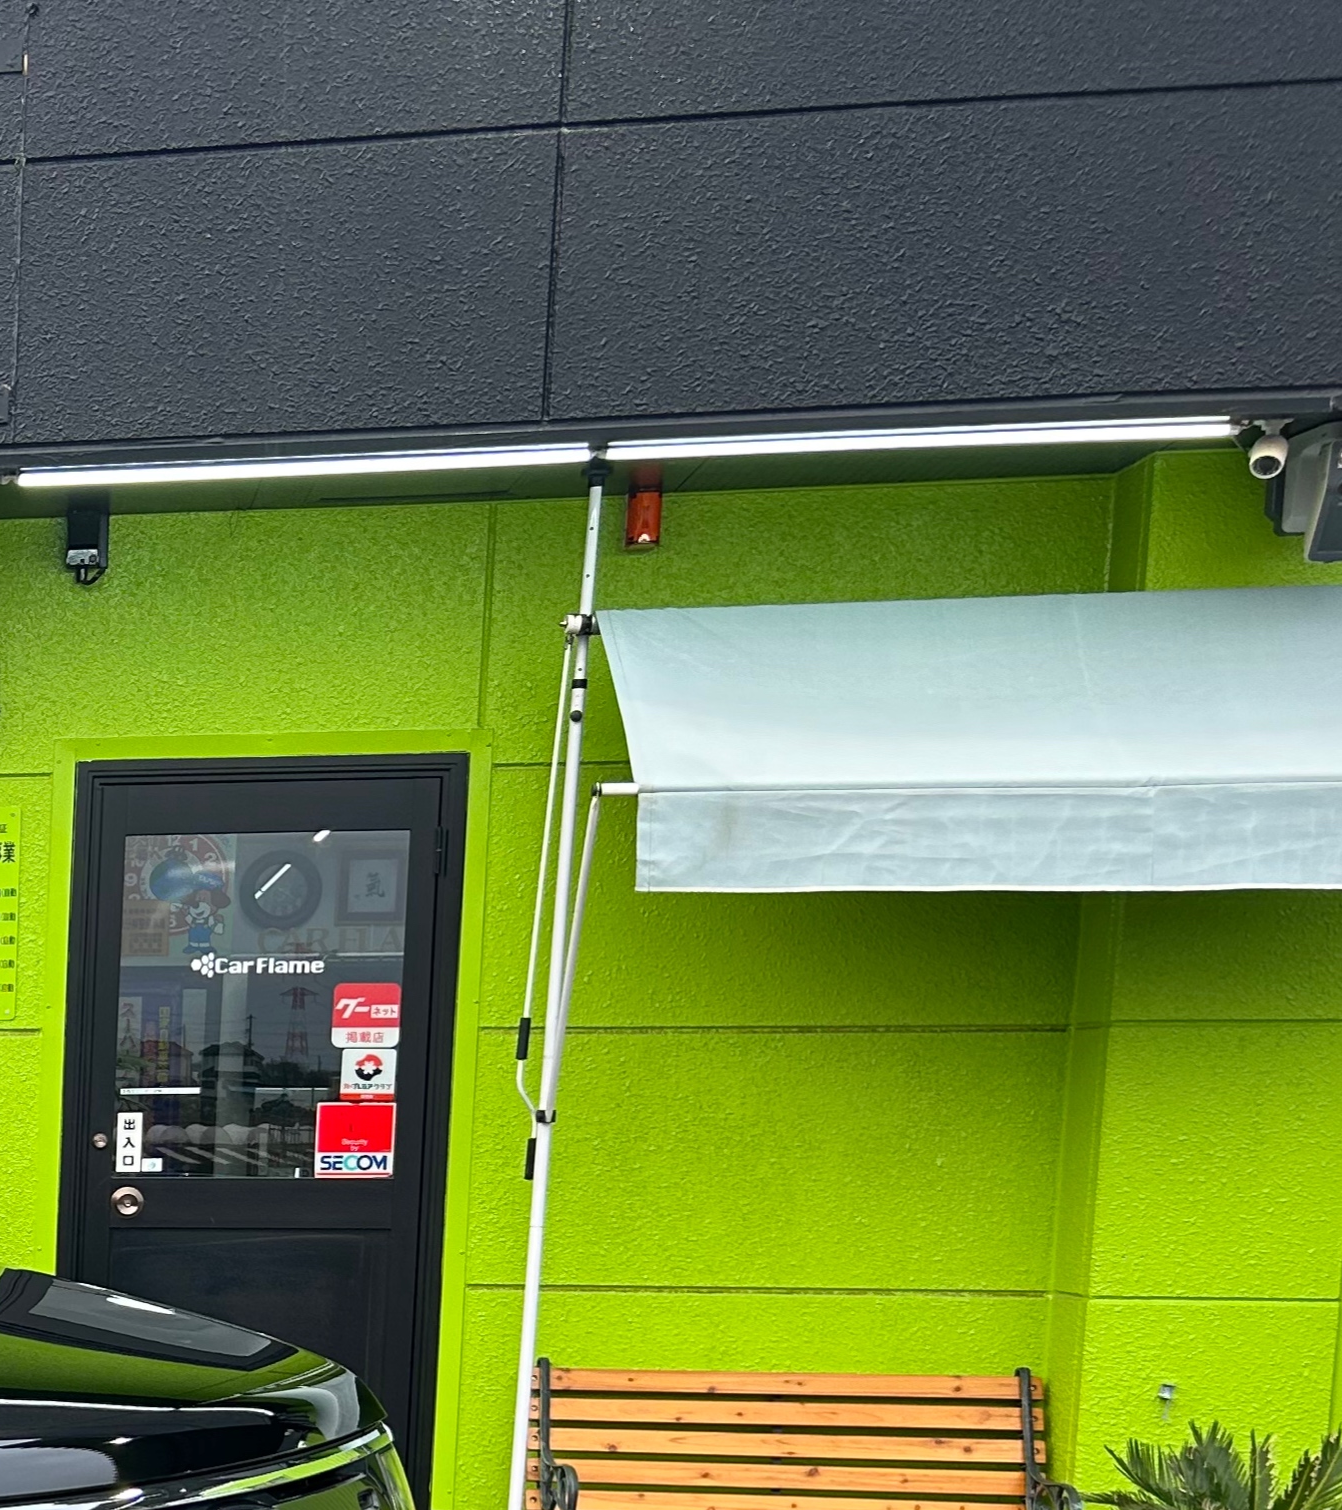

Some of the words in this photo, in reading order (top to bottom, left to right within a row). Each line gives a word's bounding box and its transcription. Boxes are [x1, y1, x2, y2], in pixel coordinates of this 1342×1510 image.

[122, 1118, 136, 1167] 出入口
[320, 1154, 388, 1171] SECOM
